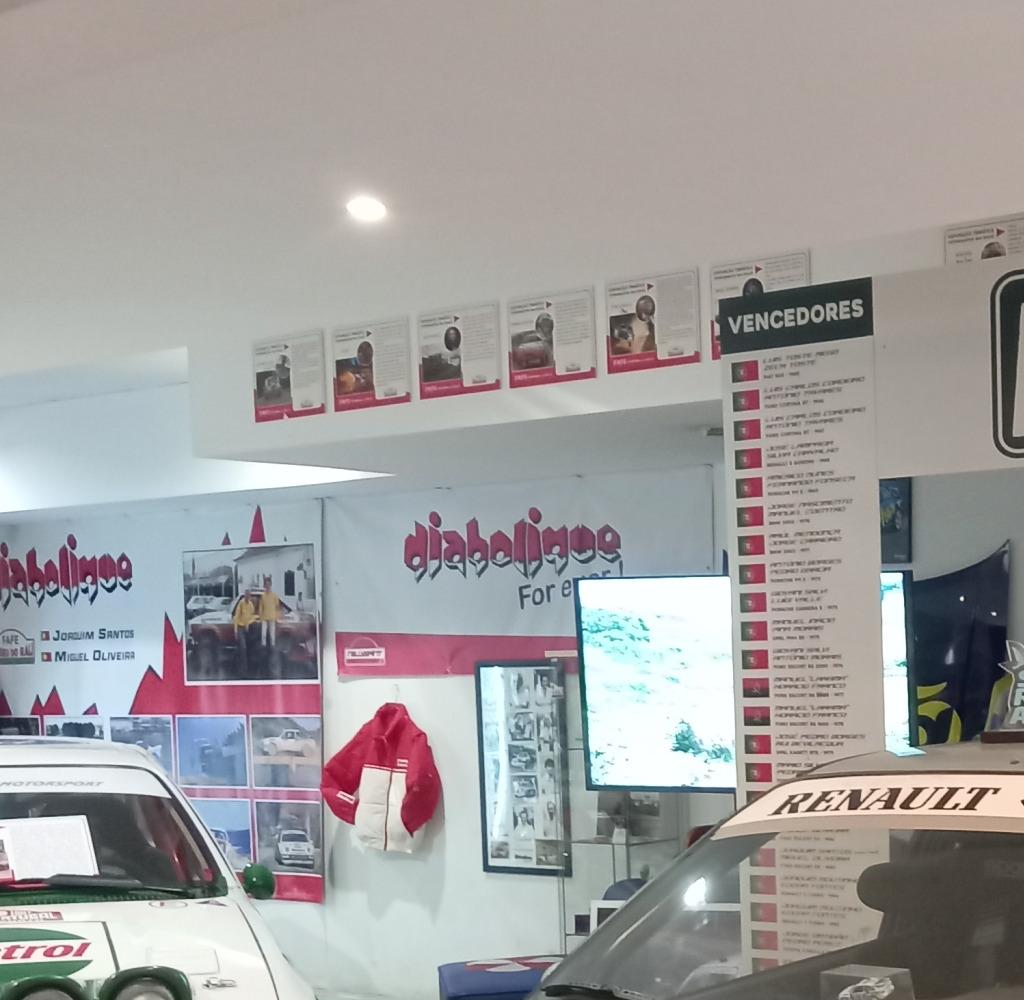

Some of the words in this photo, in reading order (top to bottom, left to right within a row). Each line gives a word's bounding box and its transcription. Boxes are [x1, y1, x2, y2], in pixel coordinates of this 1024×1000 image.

[728, 299, 864, 334] VENCEDORES
[404, 507, 621, 584] diabolique
[0, 533, 132, 612] iabolique
[768, 785, 1001, 816] RENAULT
[0, 942, 91, 959] trol
